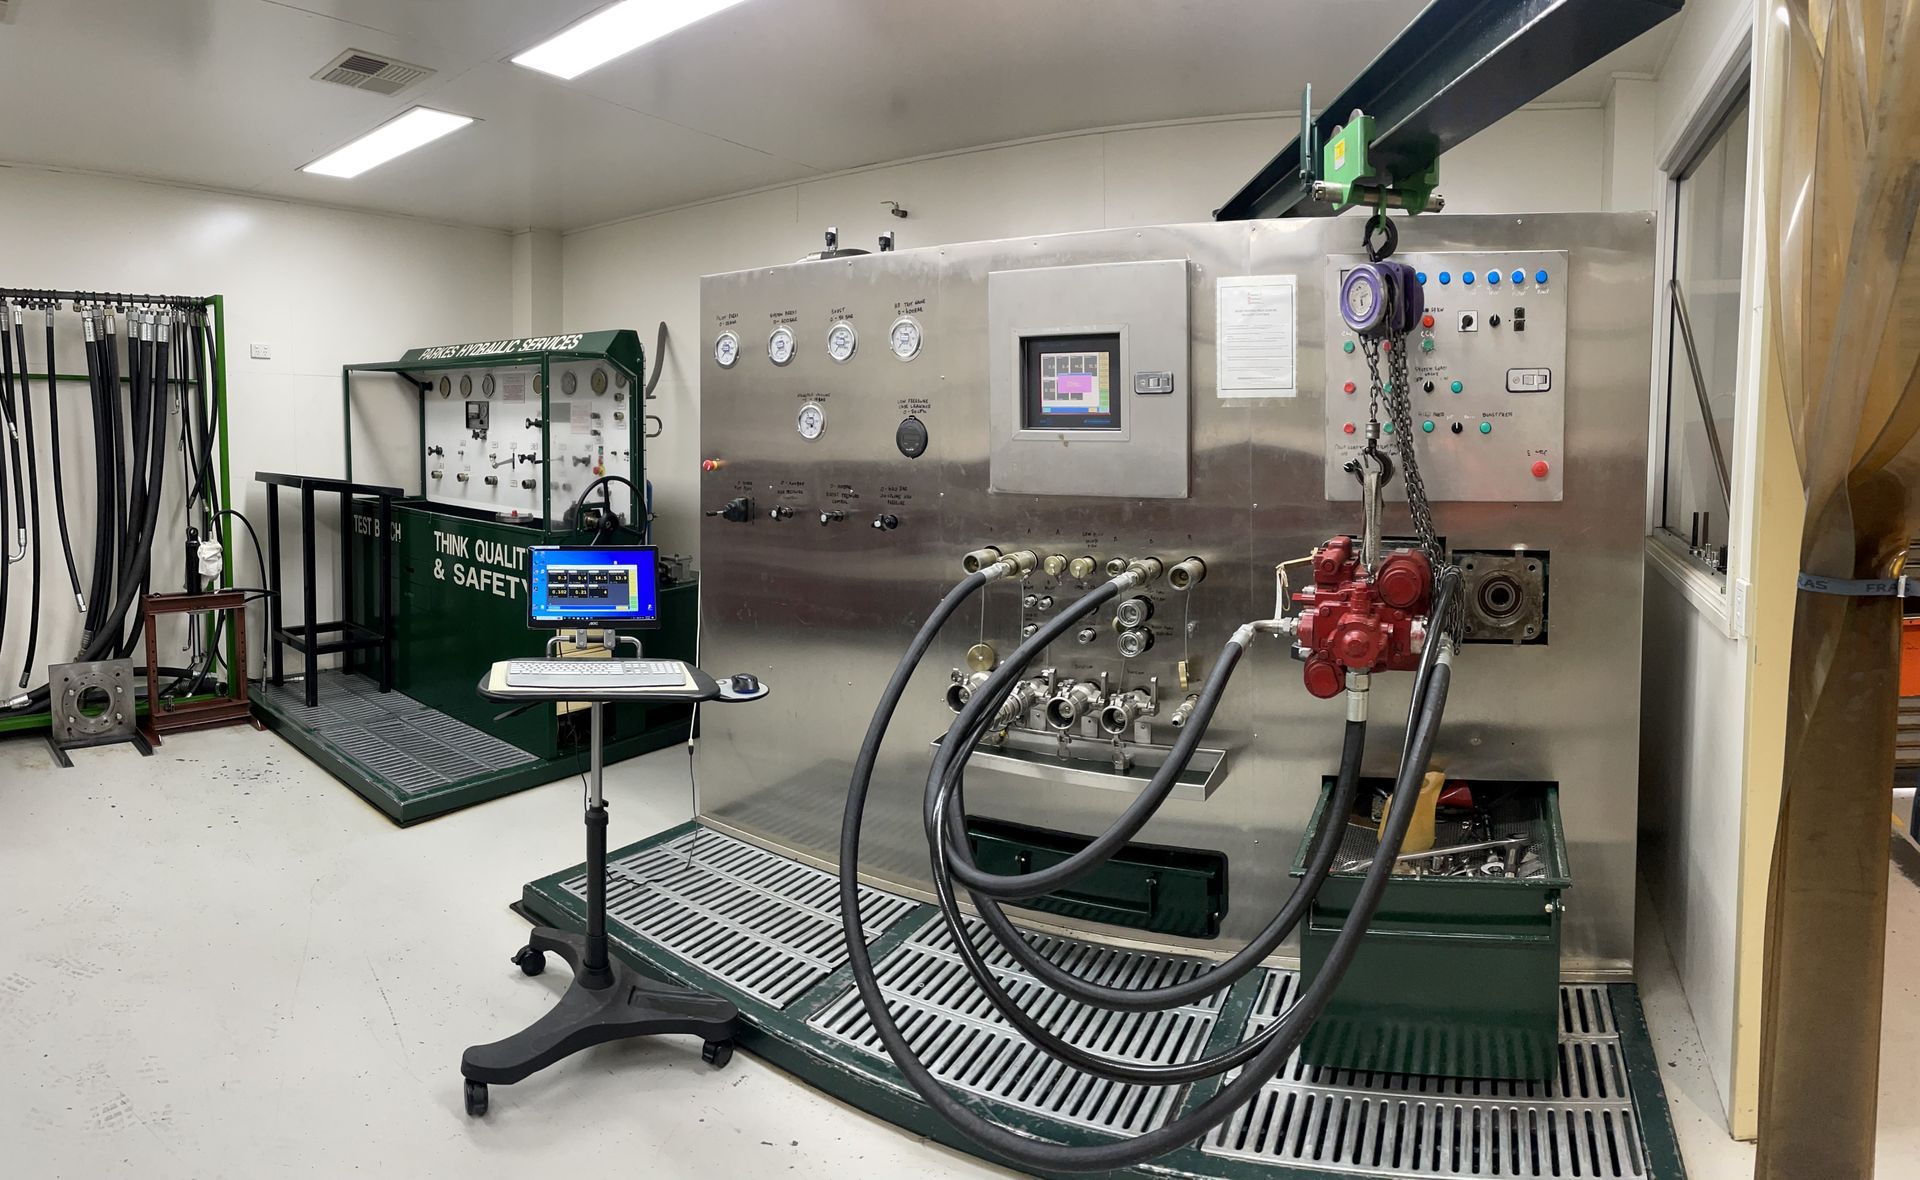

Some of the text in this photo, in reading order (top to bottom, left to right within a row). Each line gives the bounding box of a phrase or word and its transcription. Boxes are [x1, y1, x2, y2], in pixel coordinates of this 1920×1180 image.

[418, 333, 583, 361] PARKES HYDRAULIC SERVICES
[353, 514, 402, 543] TEST BCH
[434, 530, 529, 571] THINK QUALIT
[433, 558, 446, 580] &
